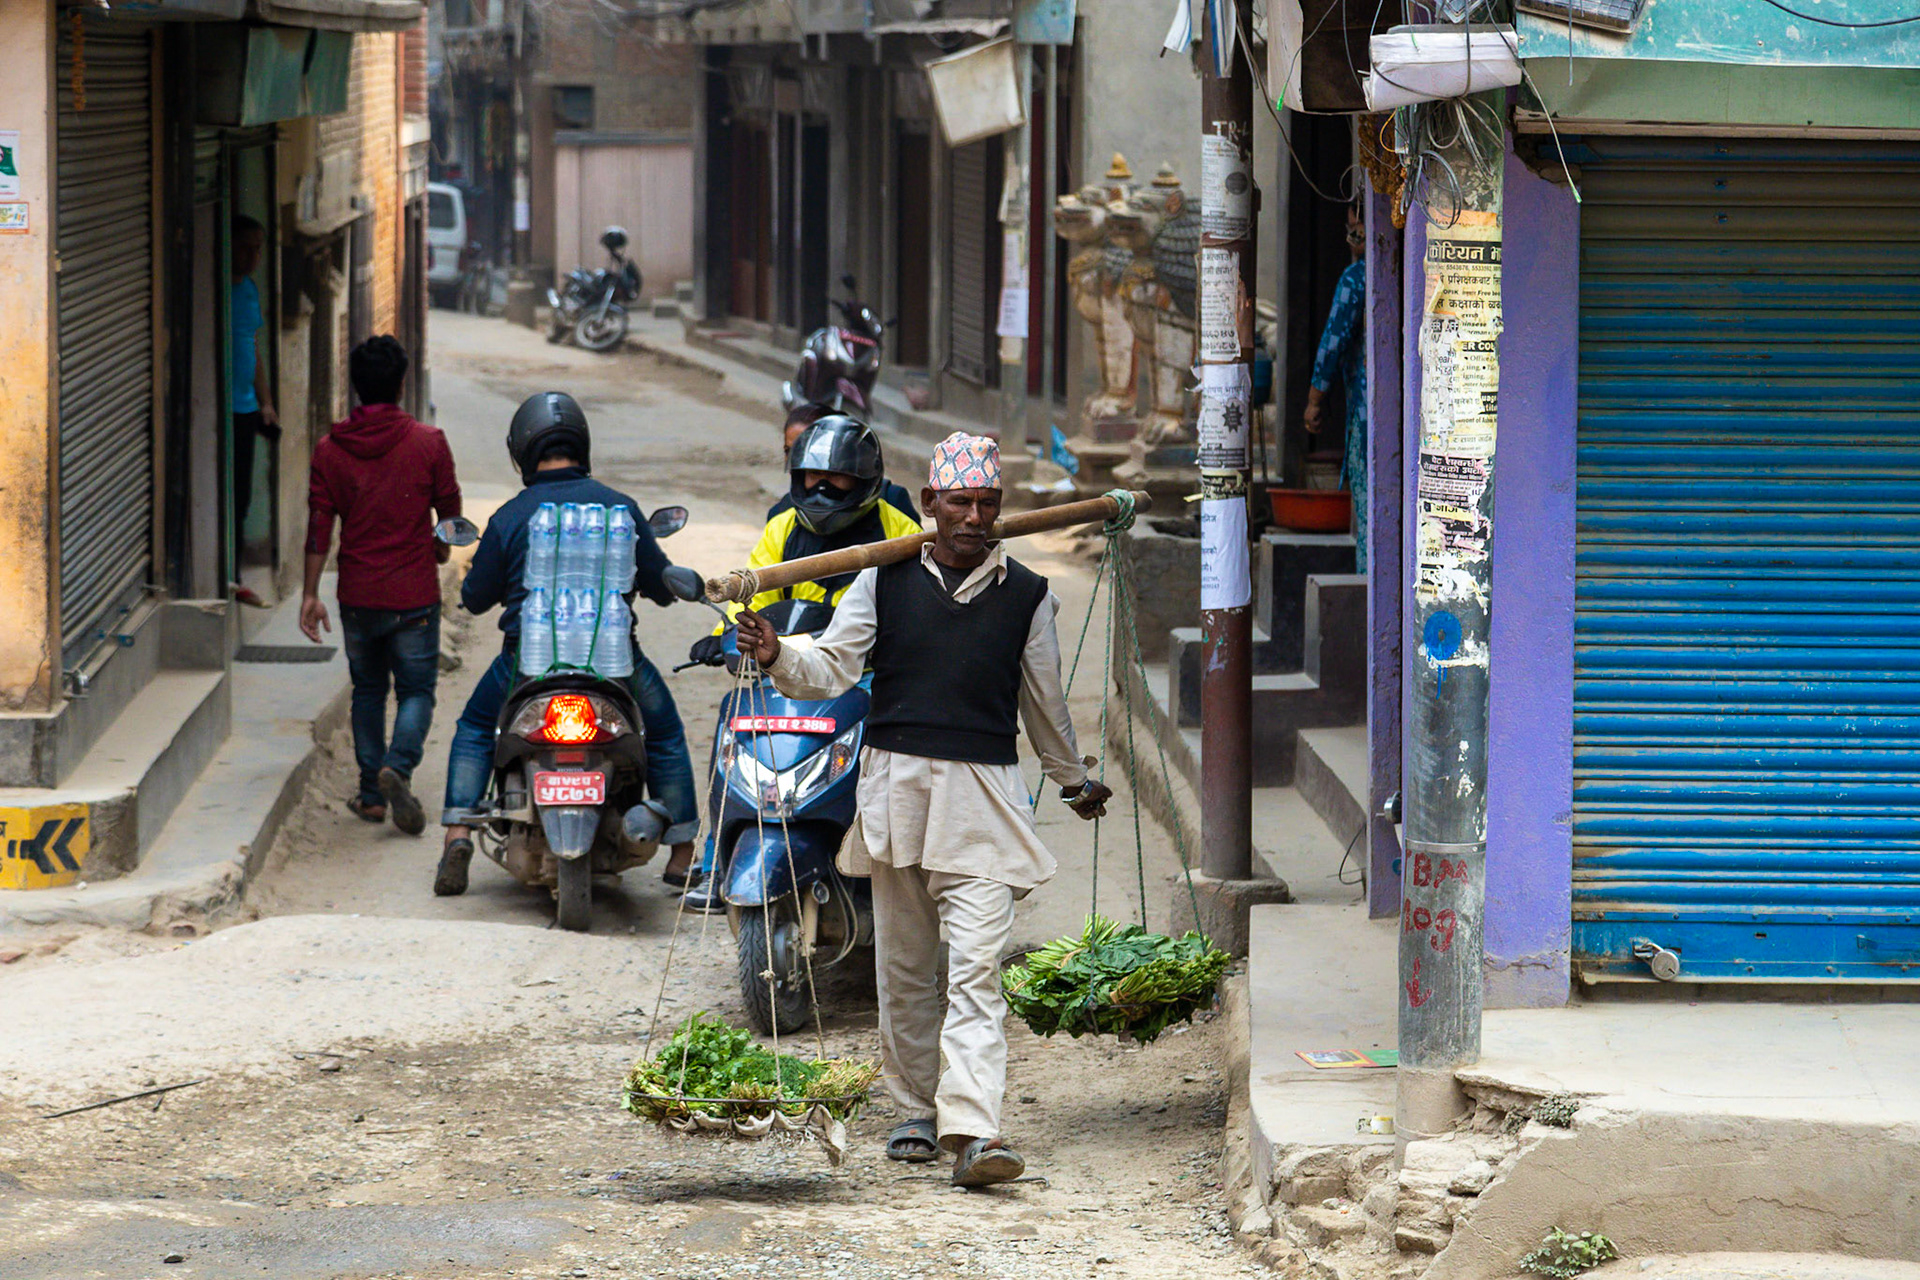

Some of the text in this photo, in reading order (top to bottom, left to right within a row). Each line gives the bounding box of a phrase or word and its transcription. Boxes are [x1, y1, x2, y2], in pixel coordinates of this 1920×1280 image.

[1428, 241, 1485, 261] कोरियन
[1462, 342, 1476, 351] ER
[541, 787, 599, 801] ५८७१
